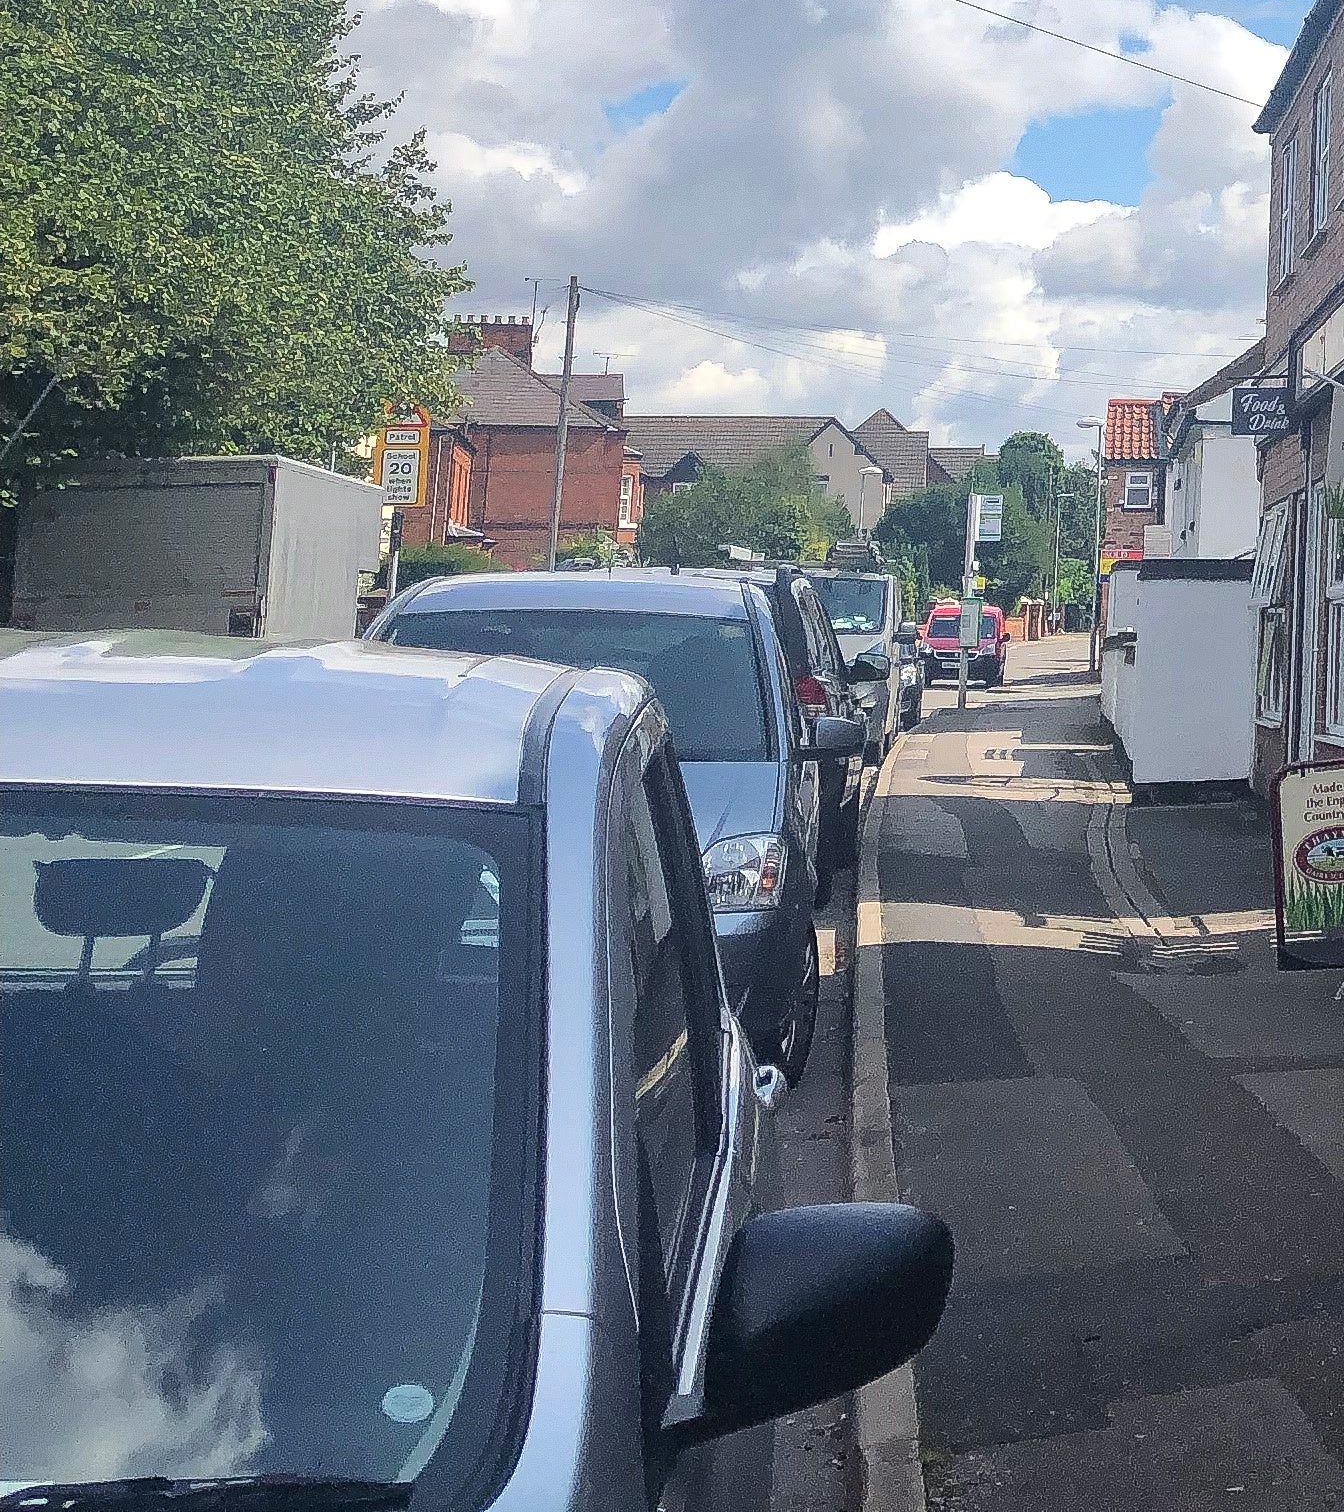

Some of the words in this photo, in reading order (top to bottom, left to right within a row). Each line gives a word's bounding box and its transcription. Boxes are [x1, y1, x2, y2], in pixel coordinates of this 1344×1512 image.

[1241, 393, 1279, 412] Food
[1277, 404, 1285, 414] &
[1249, 413, 1289, 431] Drink
[389, 433, 416, 441] Patrol
[386, 452, 416, 460] School
[389, 462, 412, 475] 20
[386, 485, 411, 494] lights
[387, 492, 410, 500] show
[1312, 782, 1342, 794] Made
[1307, 798, 1323, 808] the
